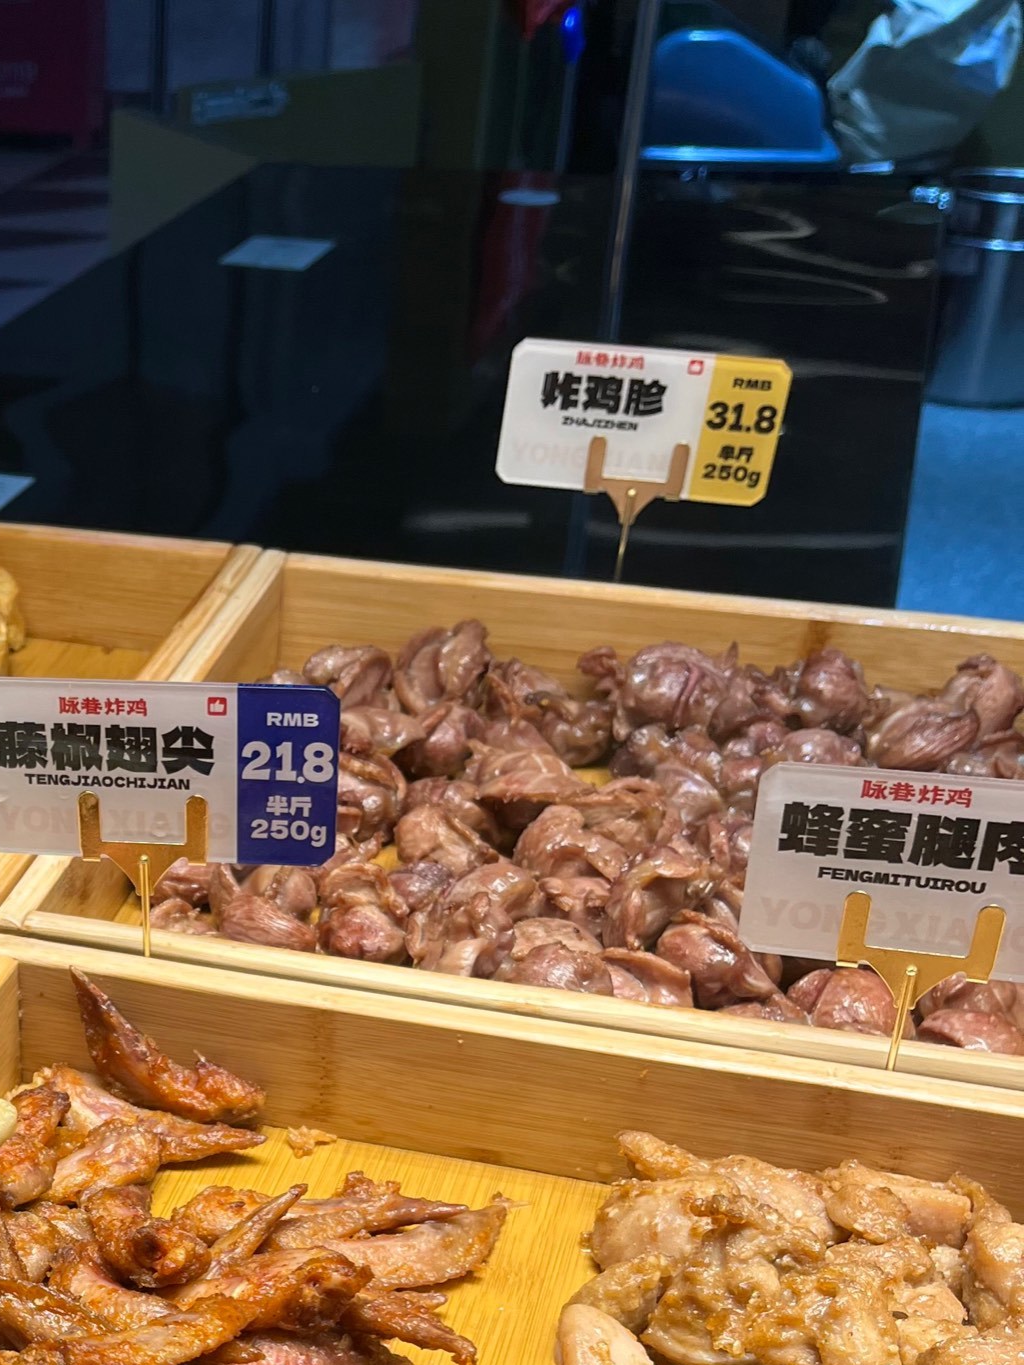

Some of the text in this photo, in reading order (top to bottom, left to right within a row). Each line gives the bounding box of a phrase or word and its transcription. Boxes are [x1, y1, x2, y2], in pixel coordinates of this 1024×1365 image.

[541, 371, 667, 417] 炸鸡胗
[732, 377, 772, 391] RMB
[706, 402, 777, 434] 31.8
[703, 464, 760, 488] 250g
[58, 696, 148, 717] 咏巷炸鸡
[266, 712, 319, 728] RMB
[241, 740, 334, 784] 21.8
[24, 773, 191, 791] TENGJIAOCHIJIAN
[860, 779, 973, 808] 咏巷炸鸡
[266, 795, 313, 818] 半斤
[250, 819, 327, 847] 250g
[777, 801, 1024, 876] 蜂蜜腿肉
[817, 866, 987, 894] FENGMITUIROU
